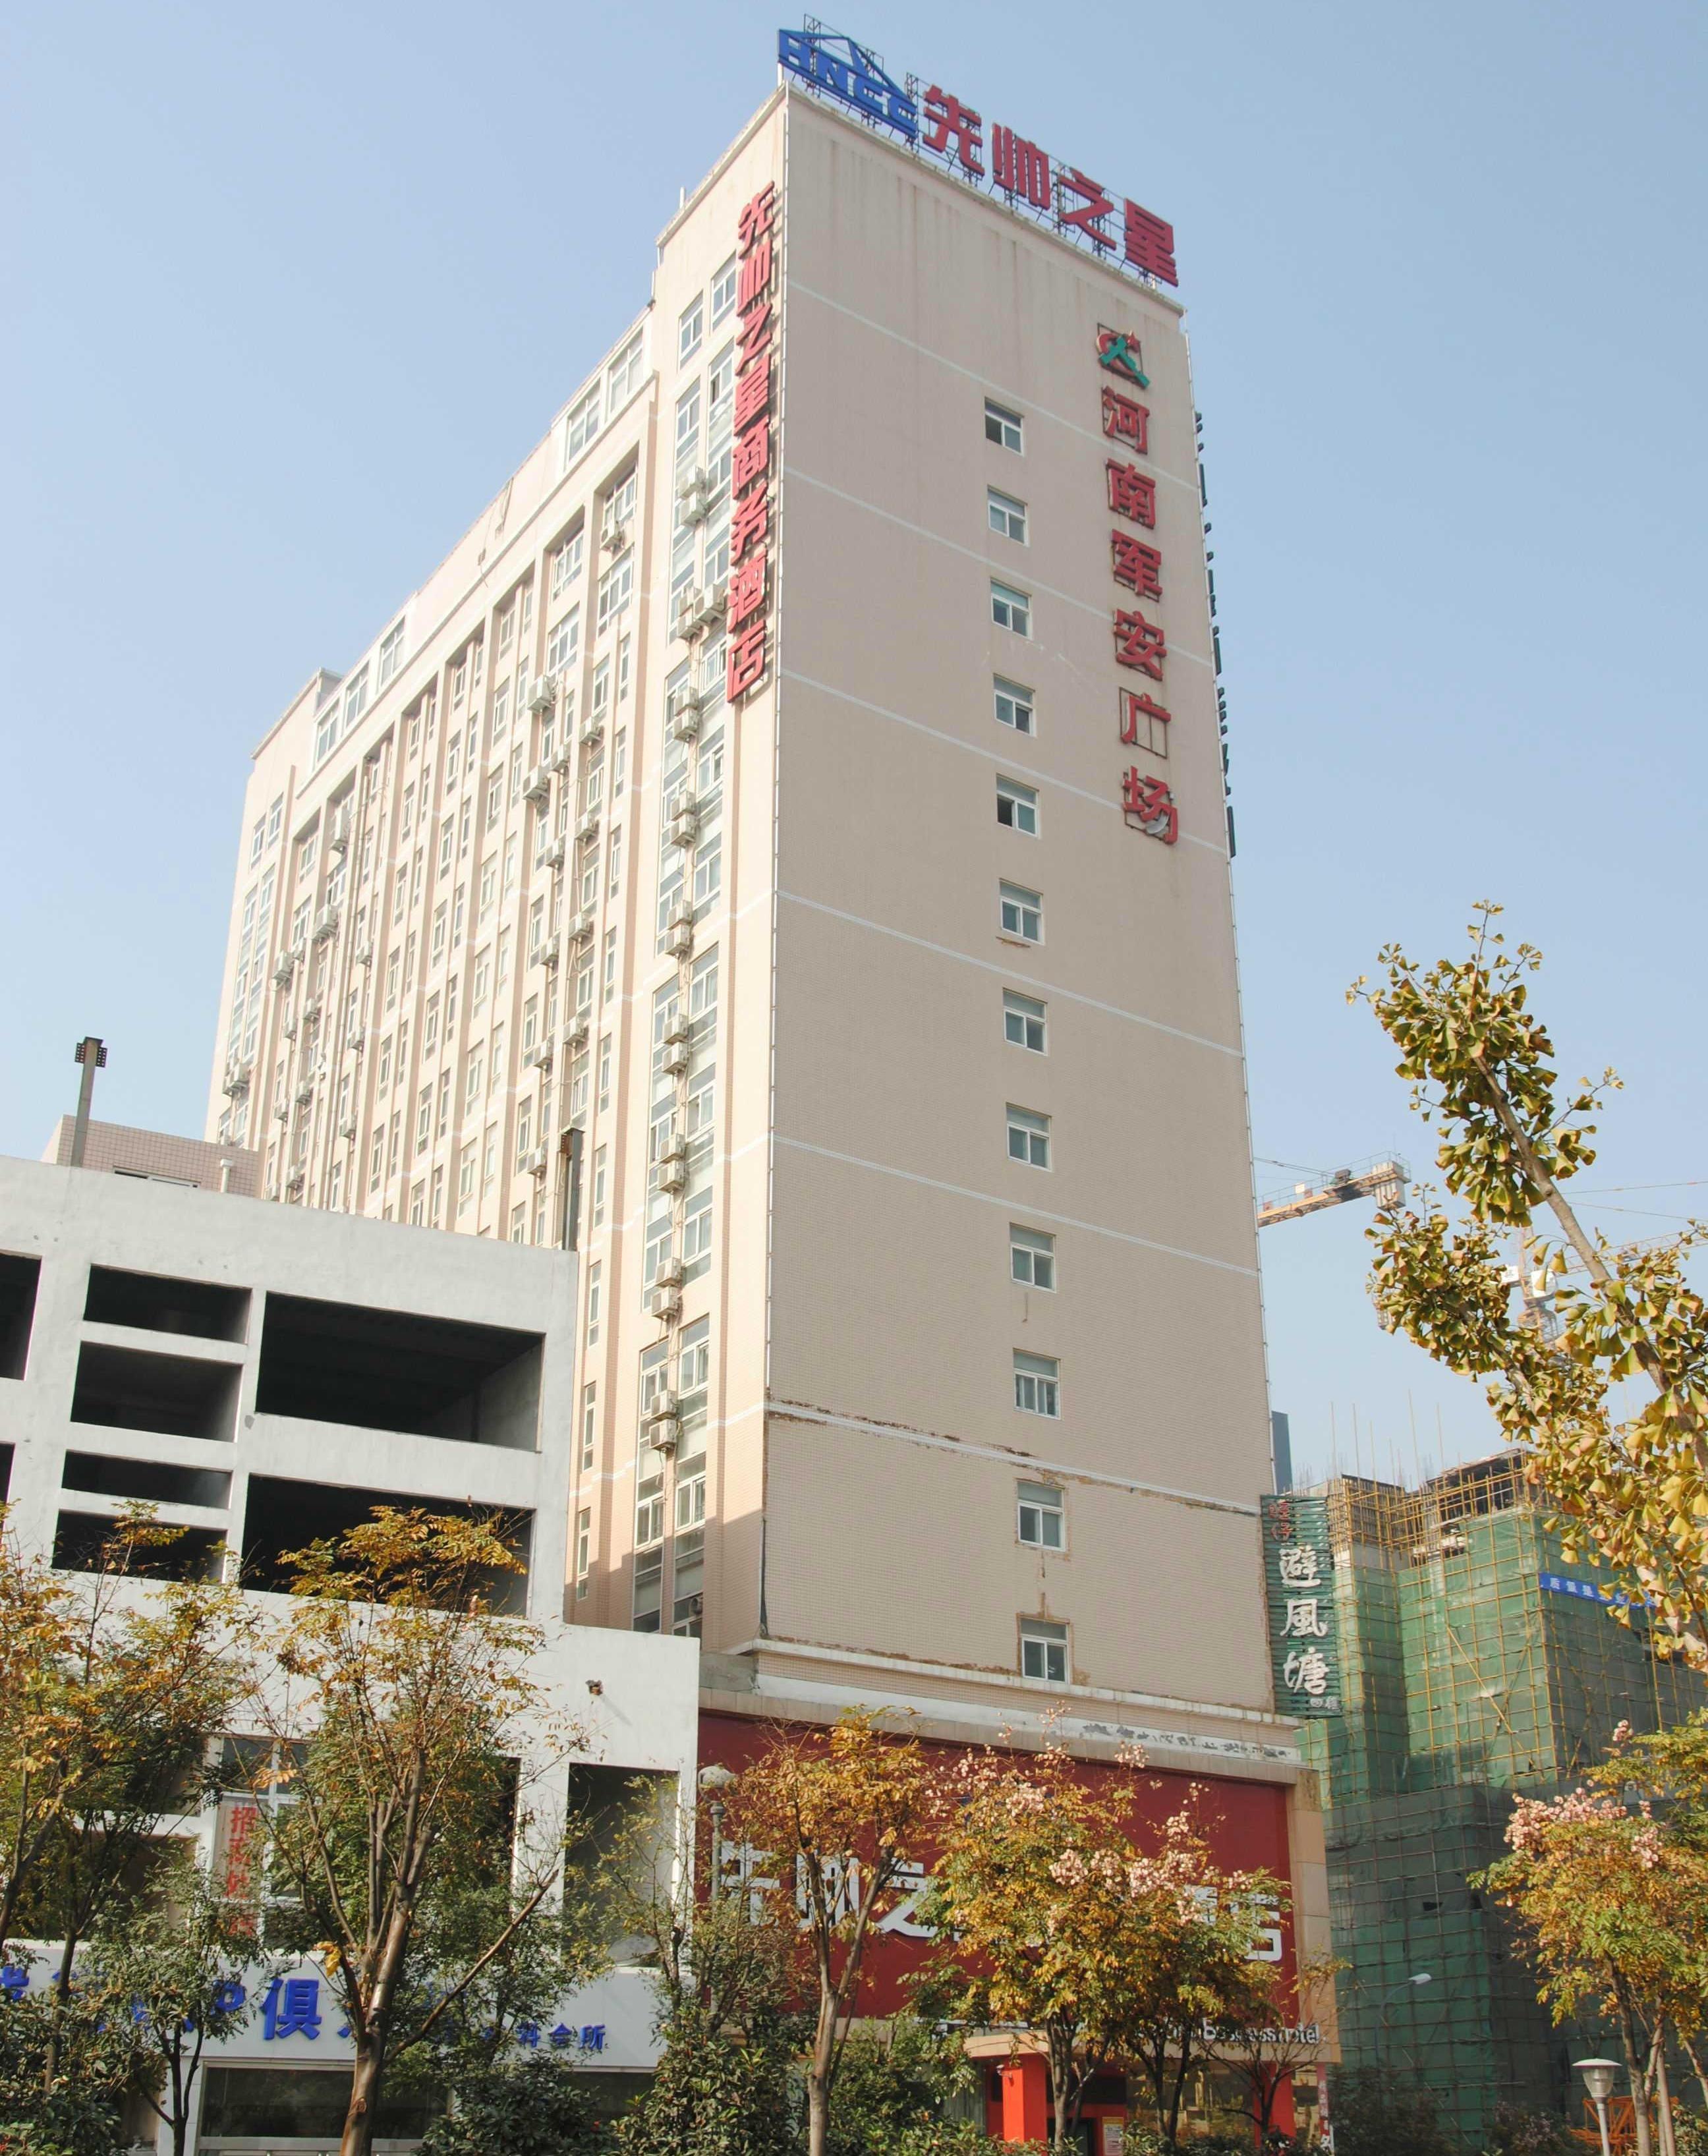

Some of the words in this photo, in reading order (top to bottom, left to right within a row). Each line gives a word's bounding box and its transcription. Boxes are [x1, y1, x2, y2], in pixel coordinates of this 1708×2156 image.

[922, 84, 1179, 288] 先帅之星
[727, 181, 775, 703] 先帅之星商务酒店
[1102, 386, 1178, 845] 河南军安广场
